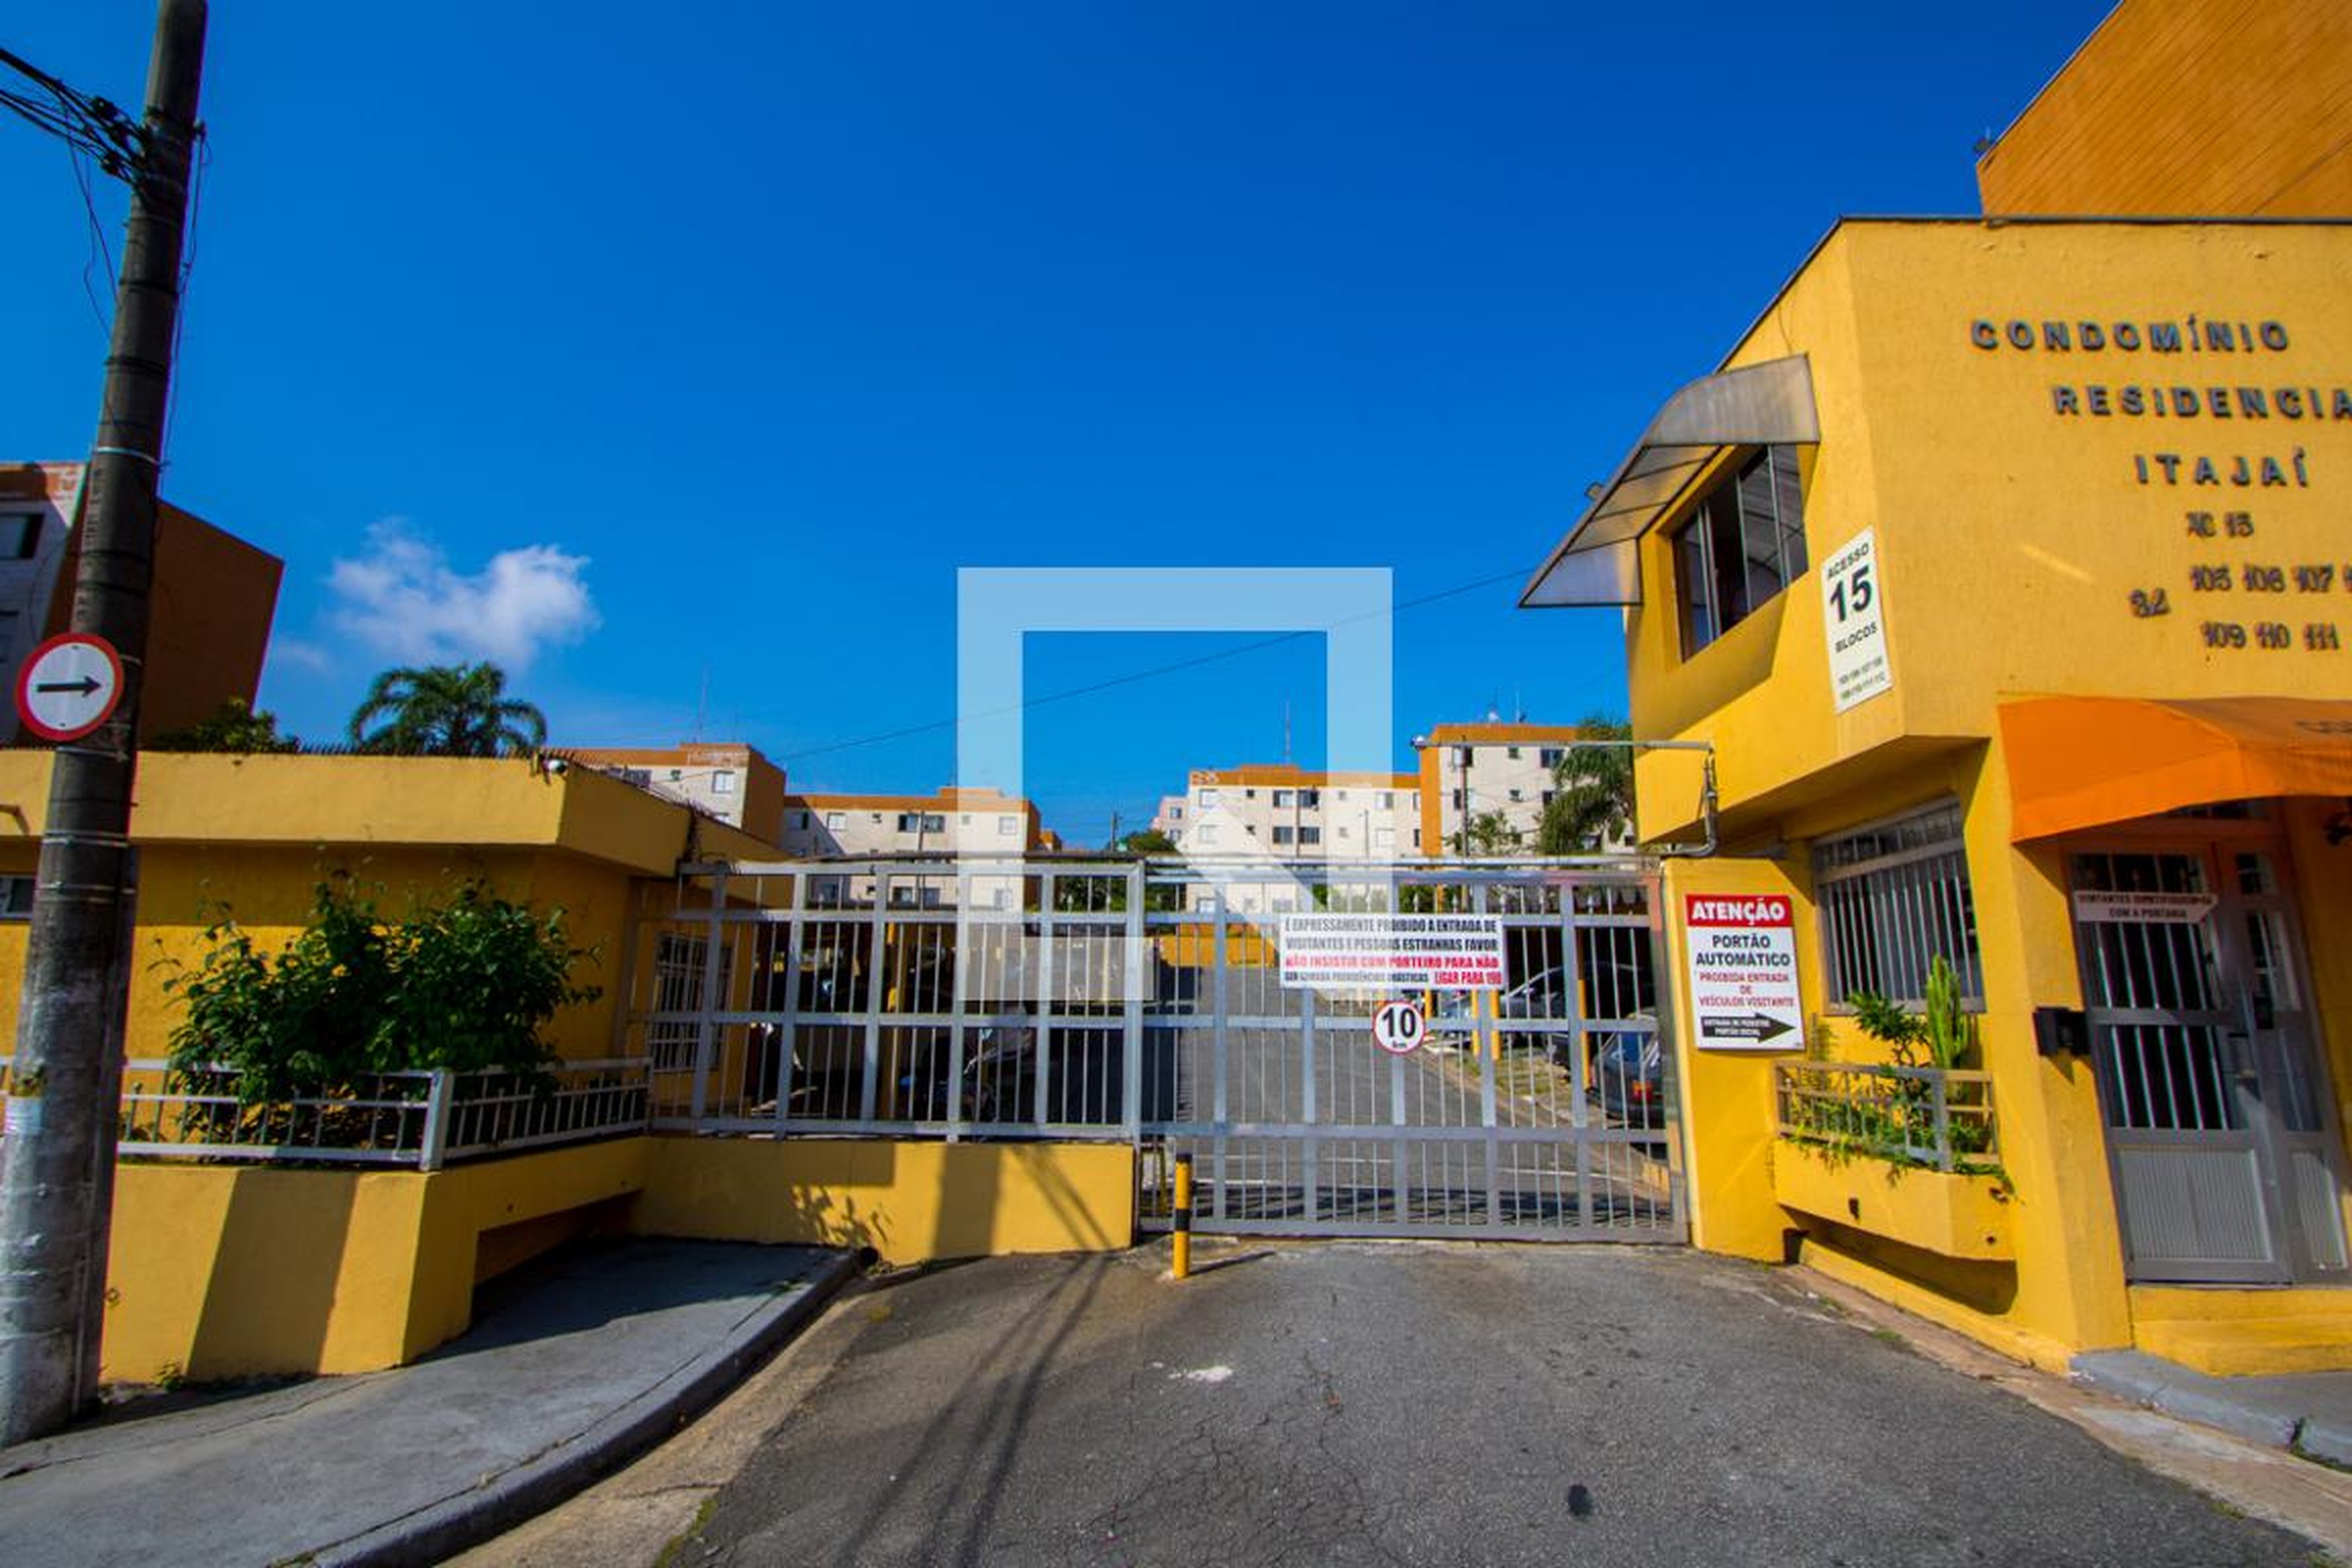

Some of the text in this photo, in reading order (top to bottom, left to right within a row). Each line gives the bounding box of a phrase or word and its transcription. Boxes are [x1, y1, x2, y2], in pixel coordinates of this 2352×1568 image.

[1971, 314, 2290, 353] CONDOMÍNIO
[2053, 385, 2352, 419] RESIDENCIA
[2135, 447, 2309, 488] ITAJAÍ
[2224, 512, 2255, 538] 15
[1828, 543, 1869, 579] ACESSO
[2292, 564, 2334, 593] 107
[1830, 564, 1872, 622] 15
[1835, 621, 1877, 654] BLOCOS
[2201, 621, 2247, 649] 109
[1692, 898, 1785, 925] ATENÇÃO
[1428, 919, 1436, 932] A
[1437, 919, 1482, 932] ENTRADA
[1484, 920, 1496, 933] DE
[1402, 938, 1462, 951] ESTRANHAS
[1464, 939, 1498, 951] FAVOR
[1713, 933, 1771, 948] PORTÃO
[1389, 956, 1441, 968] PORTEIRO
[1444, 957, 1473, 968] PARA
[1476, 954, 1499, 968] NÃO
[1696, 952, 1790, 966] AUTOMÁTICO
[1461, 971, 1483, 984] PARA
[1740, 984, 1752, 995] DE
[1382, 1007, 1416, 1038] 10
